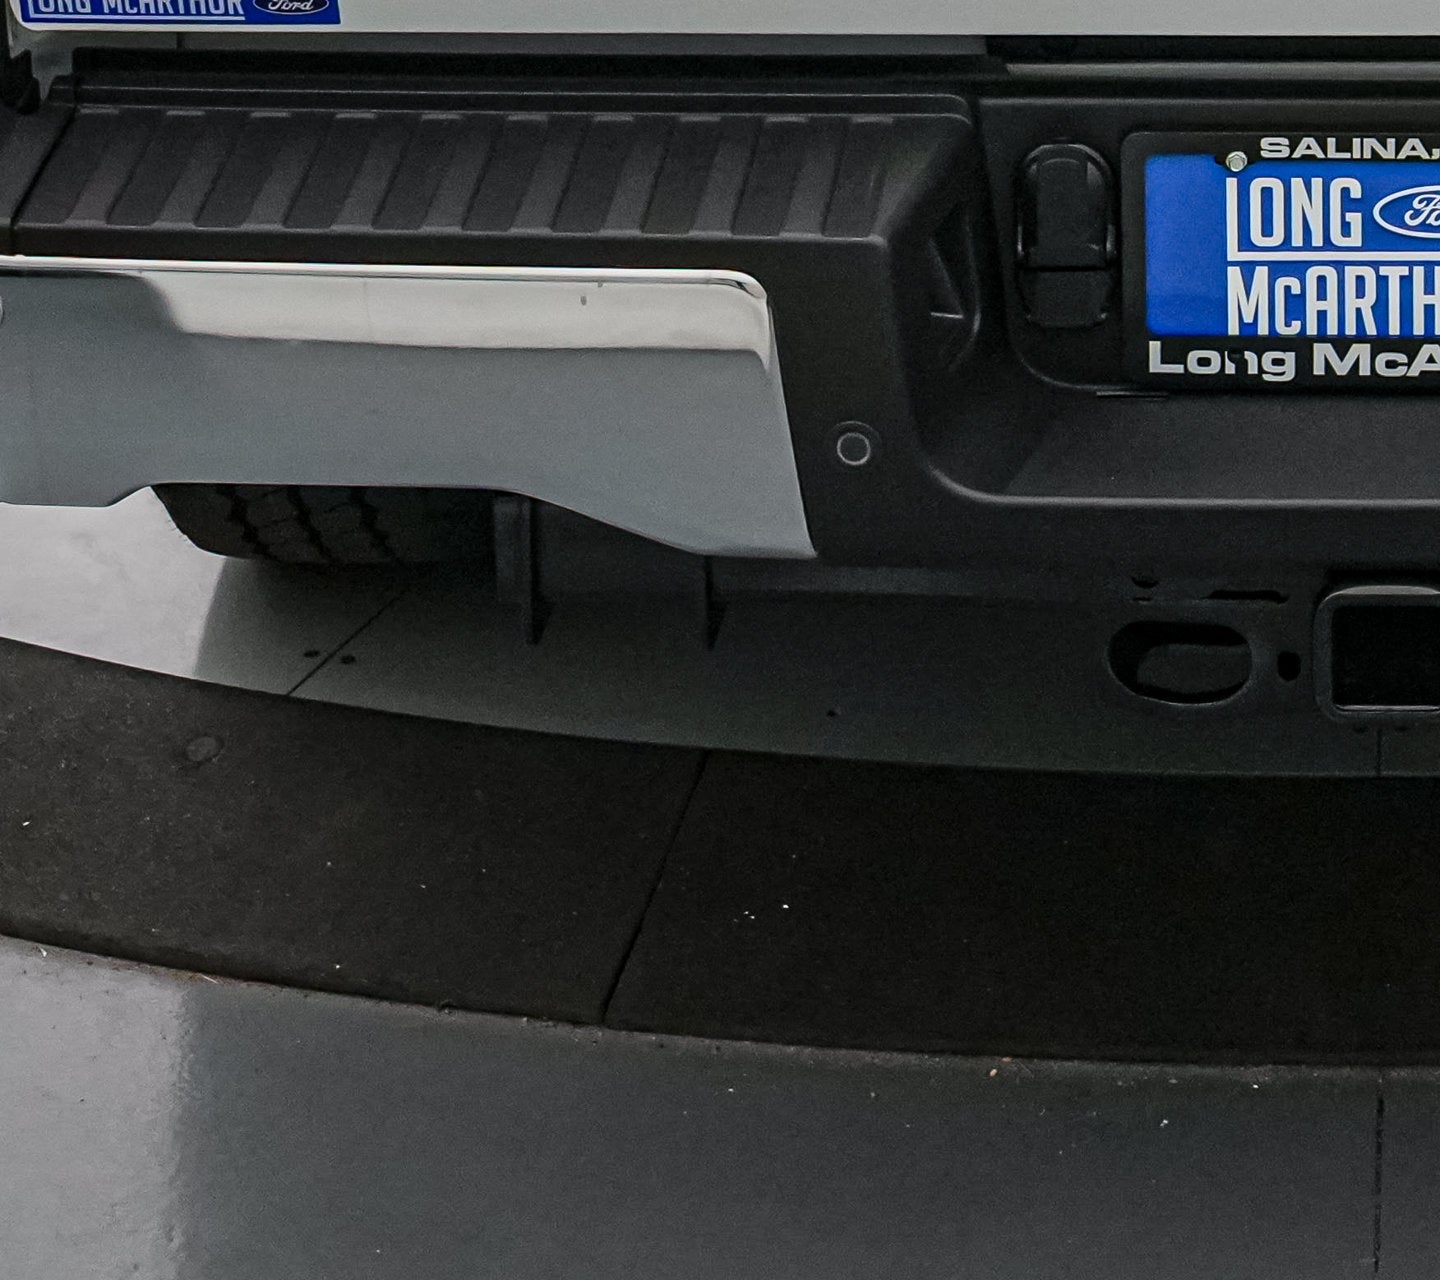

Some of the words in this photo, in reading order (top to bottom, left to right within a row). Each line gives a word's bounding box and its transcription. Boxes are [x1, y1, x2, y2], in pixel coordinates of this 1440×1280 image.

[1260, 137, 1440, 161] SALINA,
[1226, 176, 1363, 262] LONG
[1148, 341, 1296, 381] Long
